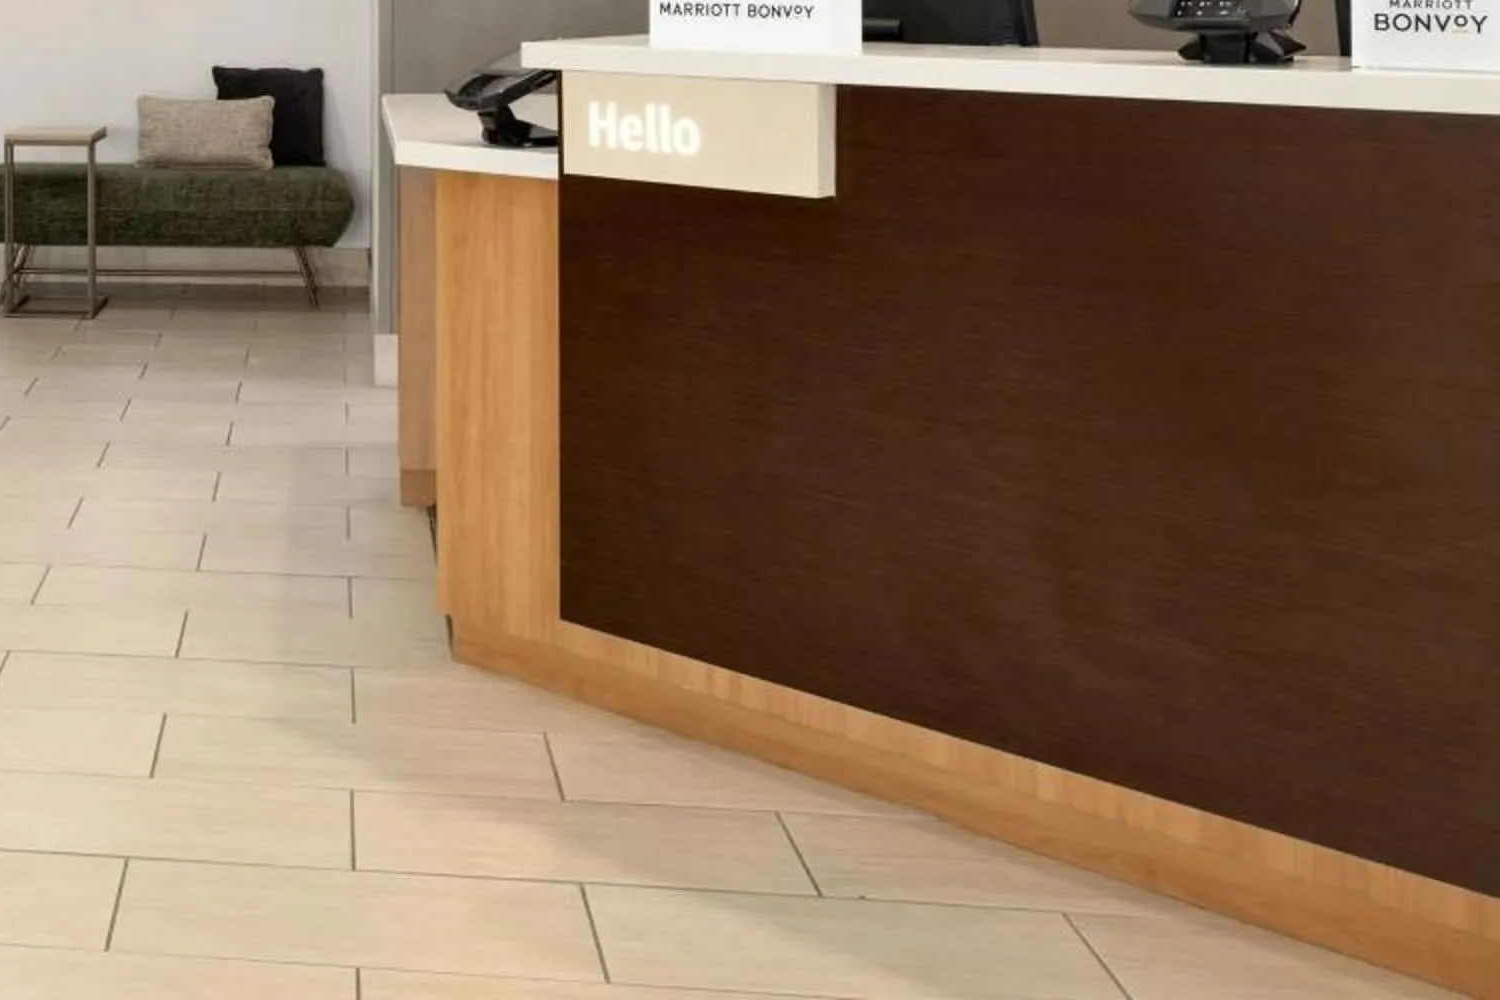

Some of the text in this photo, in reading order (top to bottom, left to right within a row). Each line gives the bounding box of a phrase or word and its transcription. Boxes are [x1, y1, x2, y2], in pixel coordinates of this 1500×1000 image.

[659, 2, 740, 17] MARRIOTT
[1389, 0, 1472, 10] MARRIOTT
[588, 100, 702, 156] Hello
